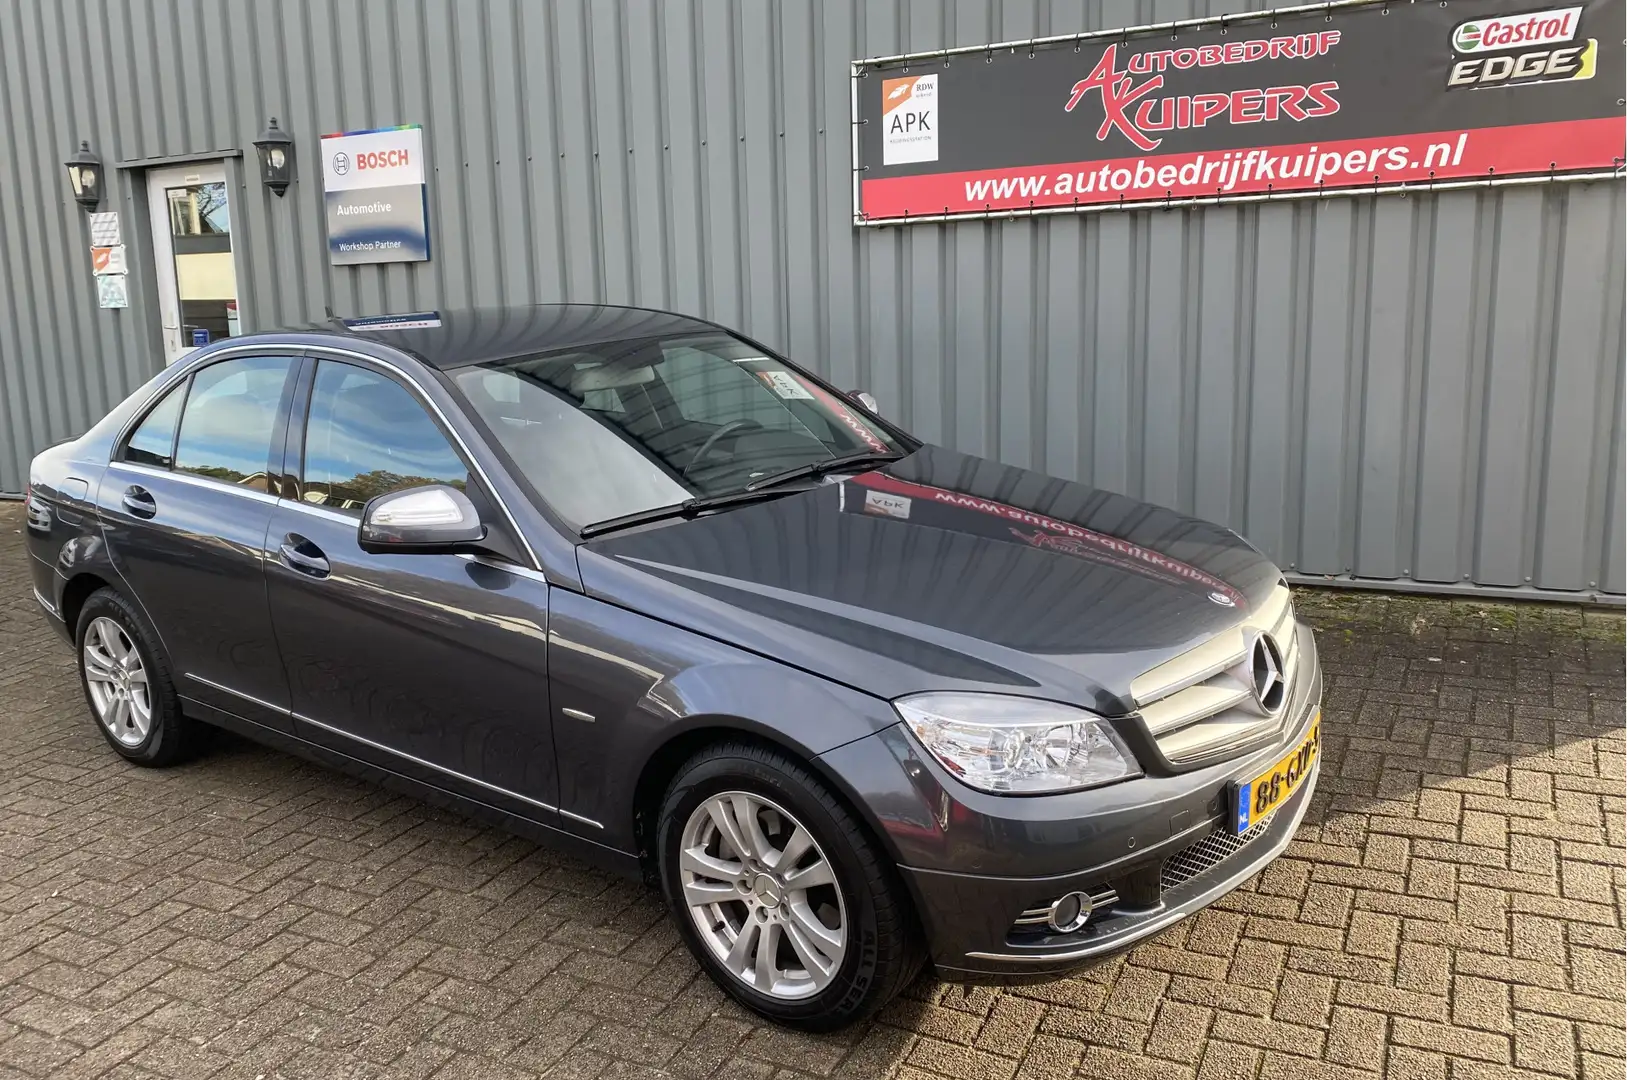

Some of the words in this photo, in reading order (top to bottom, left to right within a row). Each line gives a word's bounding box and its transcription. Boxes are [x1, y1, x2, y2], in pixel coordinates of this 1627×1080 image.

[1482, 12, 1572, 47] Castrol
[1447, 46, 1585, 87] EDGE
[916, 82, 935, 92] RDW
[890, 110, 931, 134] APK
[1096, 75, 1341, 151] KUIPERS
[356, 149, 409, 170] BOSCH
[965, 133, 1468, 202] www.autobedrijfkuipers.nl
[337, 201, 392, 216] Automotive
[339, 241, 374, 252] Workshop
[375, 240, 402, 249] Partner
[1240, 812, 1249, 825] NL
